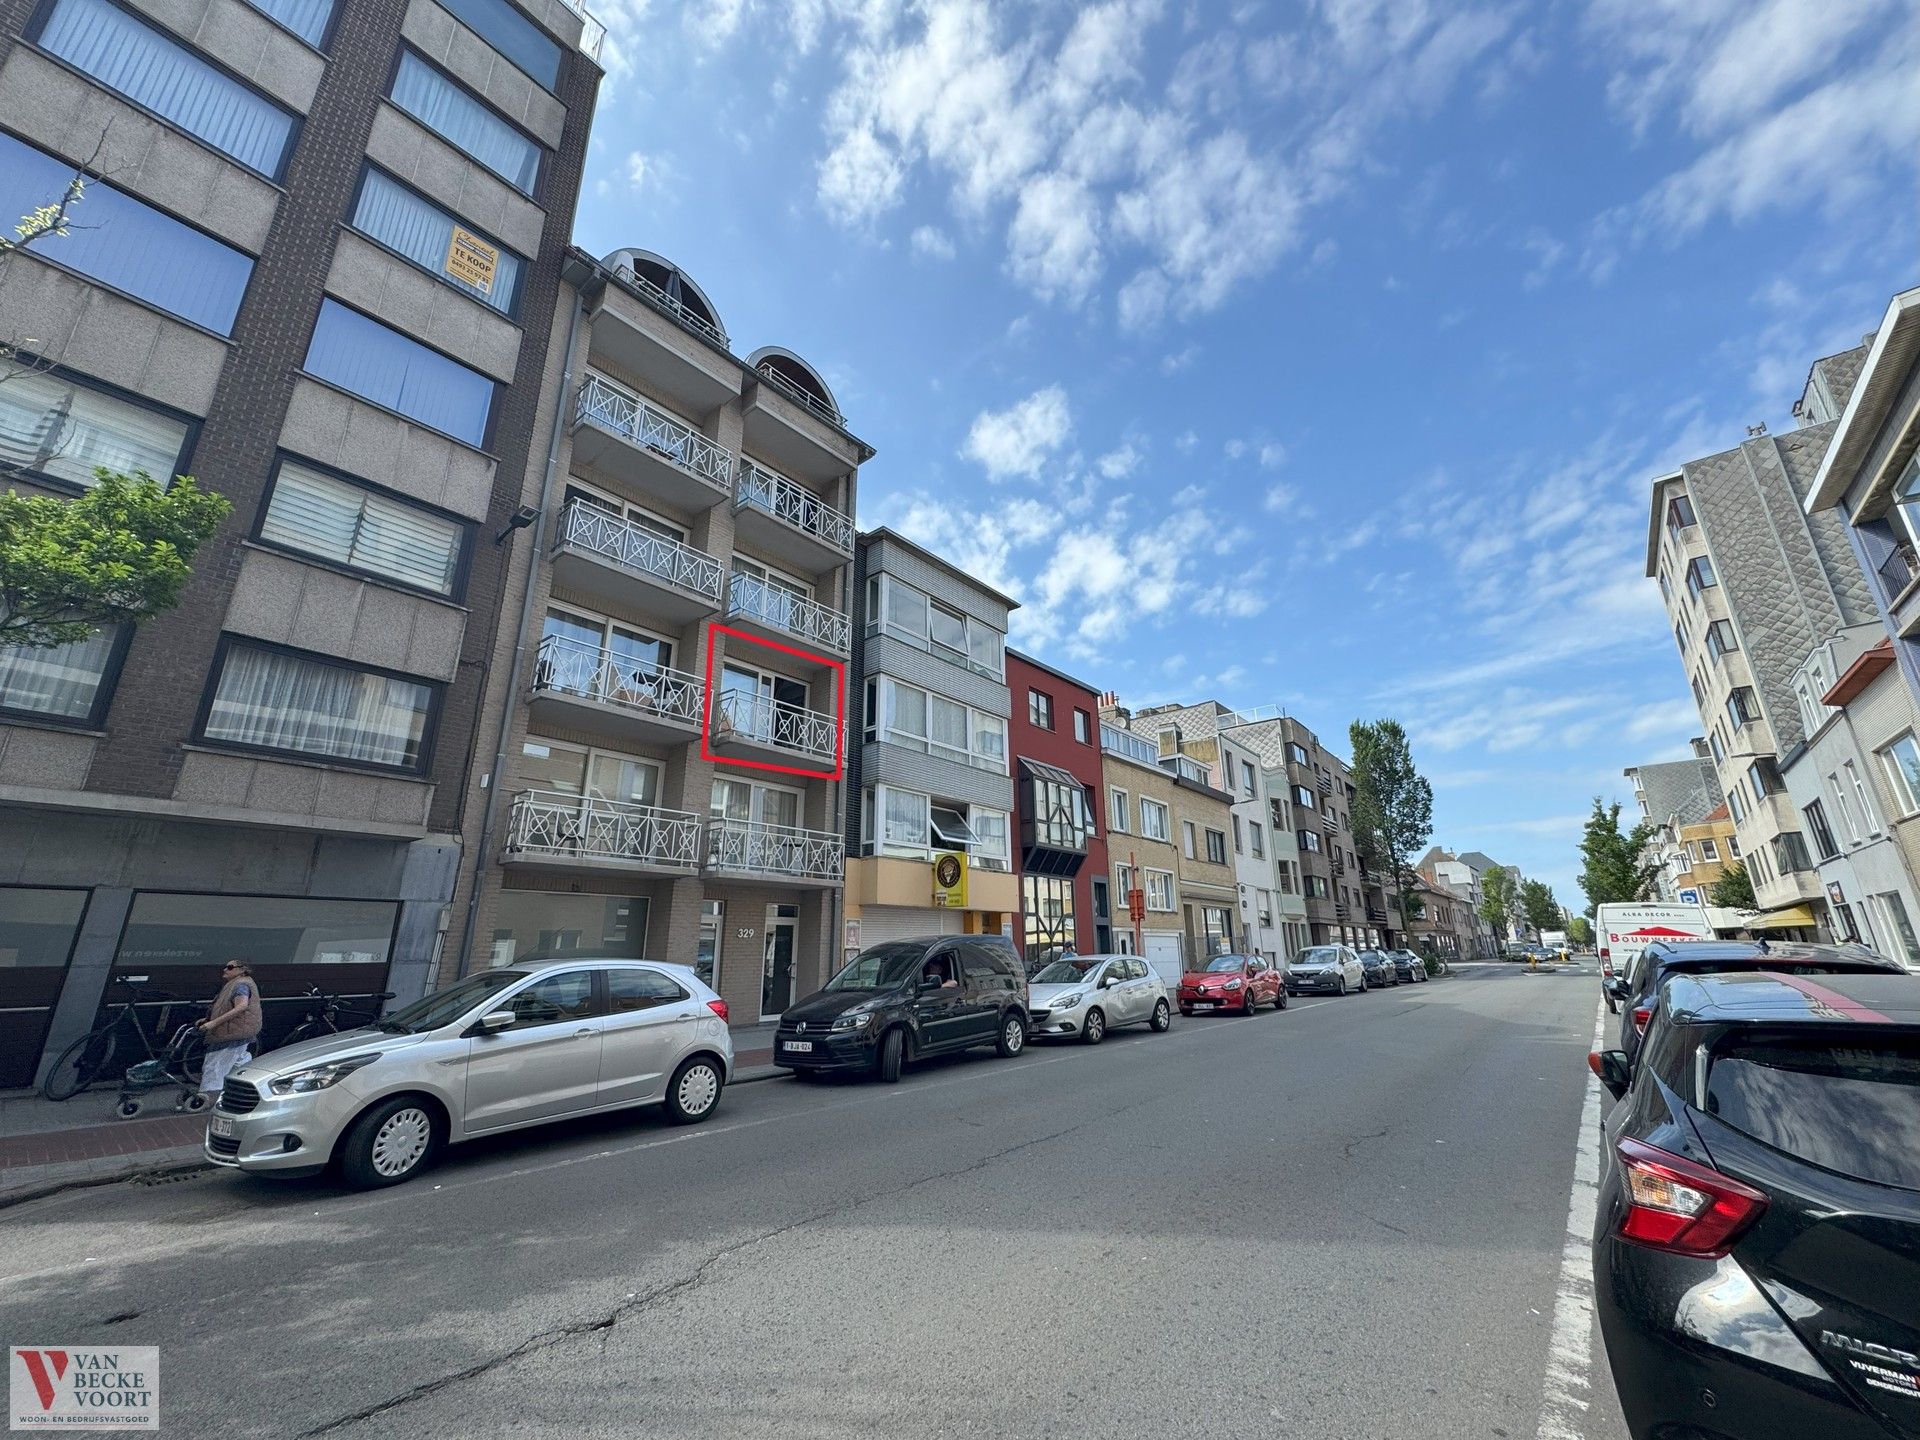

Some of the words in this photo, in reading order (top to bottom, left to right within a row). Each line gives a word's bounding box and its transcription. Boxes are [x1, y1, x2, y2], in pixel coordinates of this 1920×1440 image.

[455, 248, 465, 259] TE
[467, 254, 491, 273] KOOP
[738, 928, 755, 938] 329
